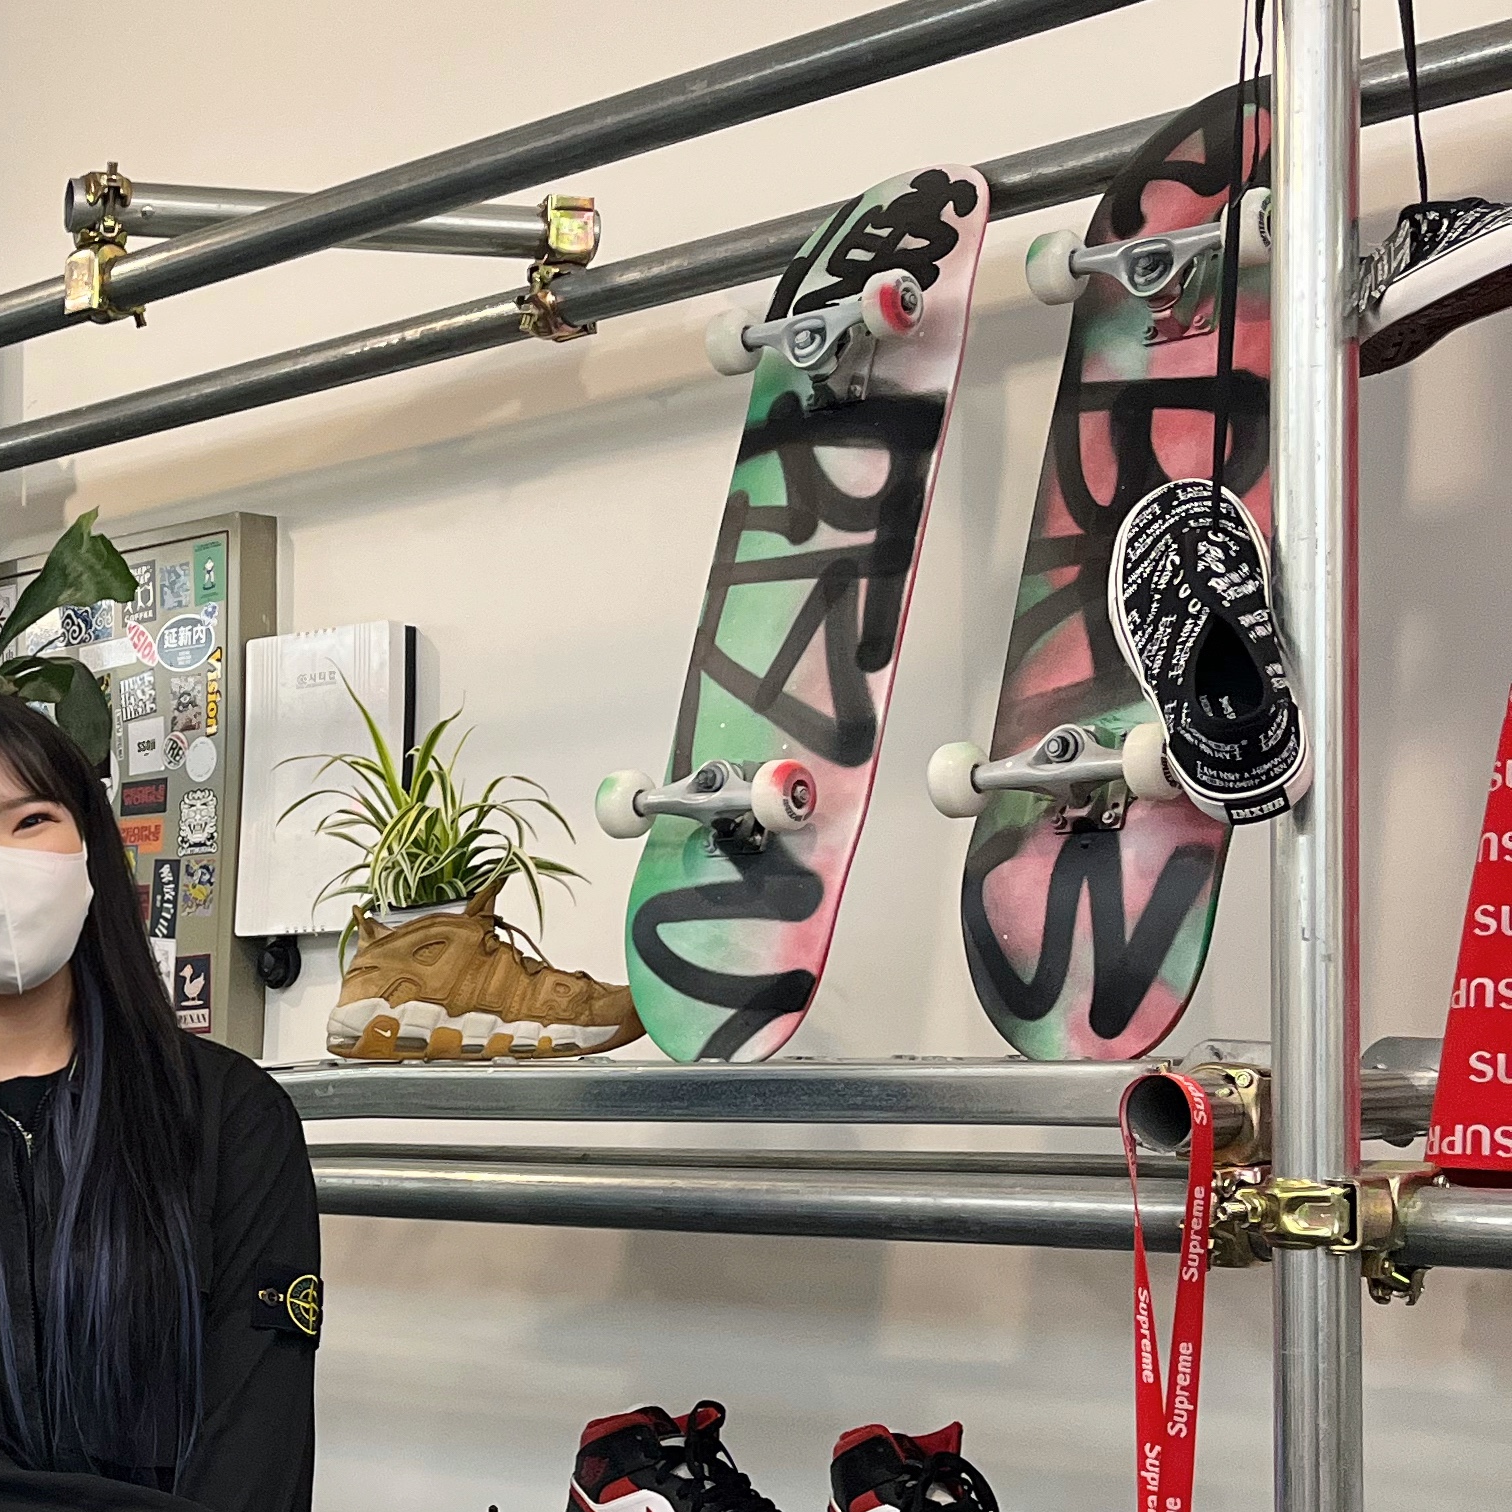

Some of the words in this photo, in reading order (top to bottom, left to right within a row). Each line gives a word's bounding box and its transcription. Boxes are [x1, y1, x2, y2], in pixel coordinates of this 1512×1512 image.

[128, 623, 157, 665] VISION
[1182, 1185, 1205, 1283] Supreme
[1136, 1286, 1155, 1385] Supreme
[1167, 1341, 1194, 1439] Supreme
